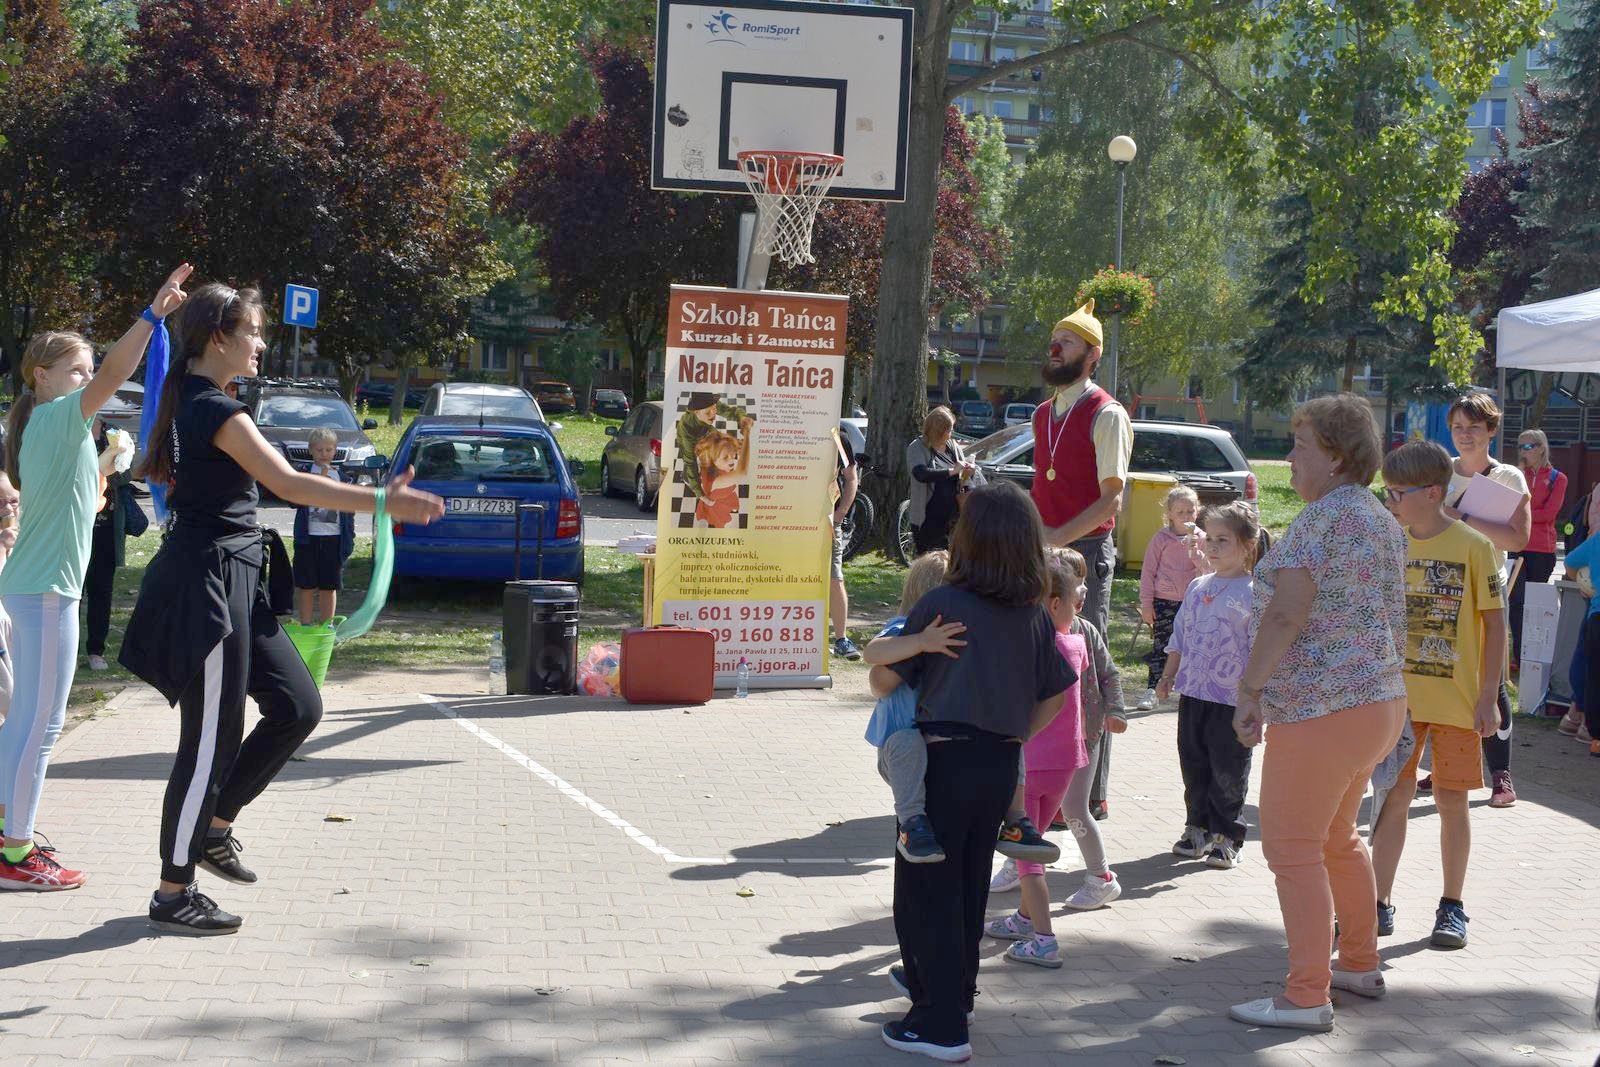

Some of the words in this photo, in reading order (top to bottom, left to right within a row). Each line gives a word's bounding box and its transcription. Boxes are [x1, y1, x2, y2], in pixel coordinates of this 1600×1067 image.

[742, 23, 800, 36] RomiSport
[291, 290, 311, 321] P
[680, 301, 760, 327] Szkoła
[767, 306, 836, 331] Tańca
[680, 329, 743, 345] Kurzak
[747, 333, 754, 345] i
[757, 333, 835, 350] Zamorski
[678, 354, 753, 386] Nauka
[764, 358, 834, 390] Tańca
[453, 499, 470, 511] DJ
[478, 501, 514, 513] 12783
[668, 537, 745, 546] ORGANIZUJEMY:
[711, 551, 759, 560] studniówki,
[680, 562, 713, 573] imprezy
[680, 574, 697, 584] bale
[698, 575, 744, 585] maturalne,
[745, 574, 784, 586] dyskoteki
[785, 575, 798, 584] dla
[679, 587, 712, 597] turnieje
[713, 587, 750, 596] taneczne
[673, 611, 693, 621] tel.
[698, 606, 732, 621] 601
[740, 606, 774, 621] 919
[781, 606, 815, 621] 736
[710, 628, 732, 643] 09
[740, 628, 774, 643] 160
[779, 627, 814, 642] 818
[778, 647, 791, 656] 25,
